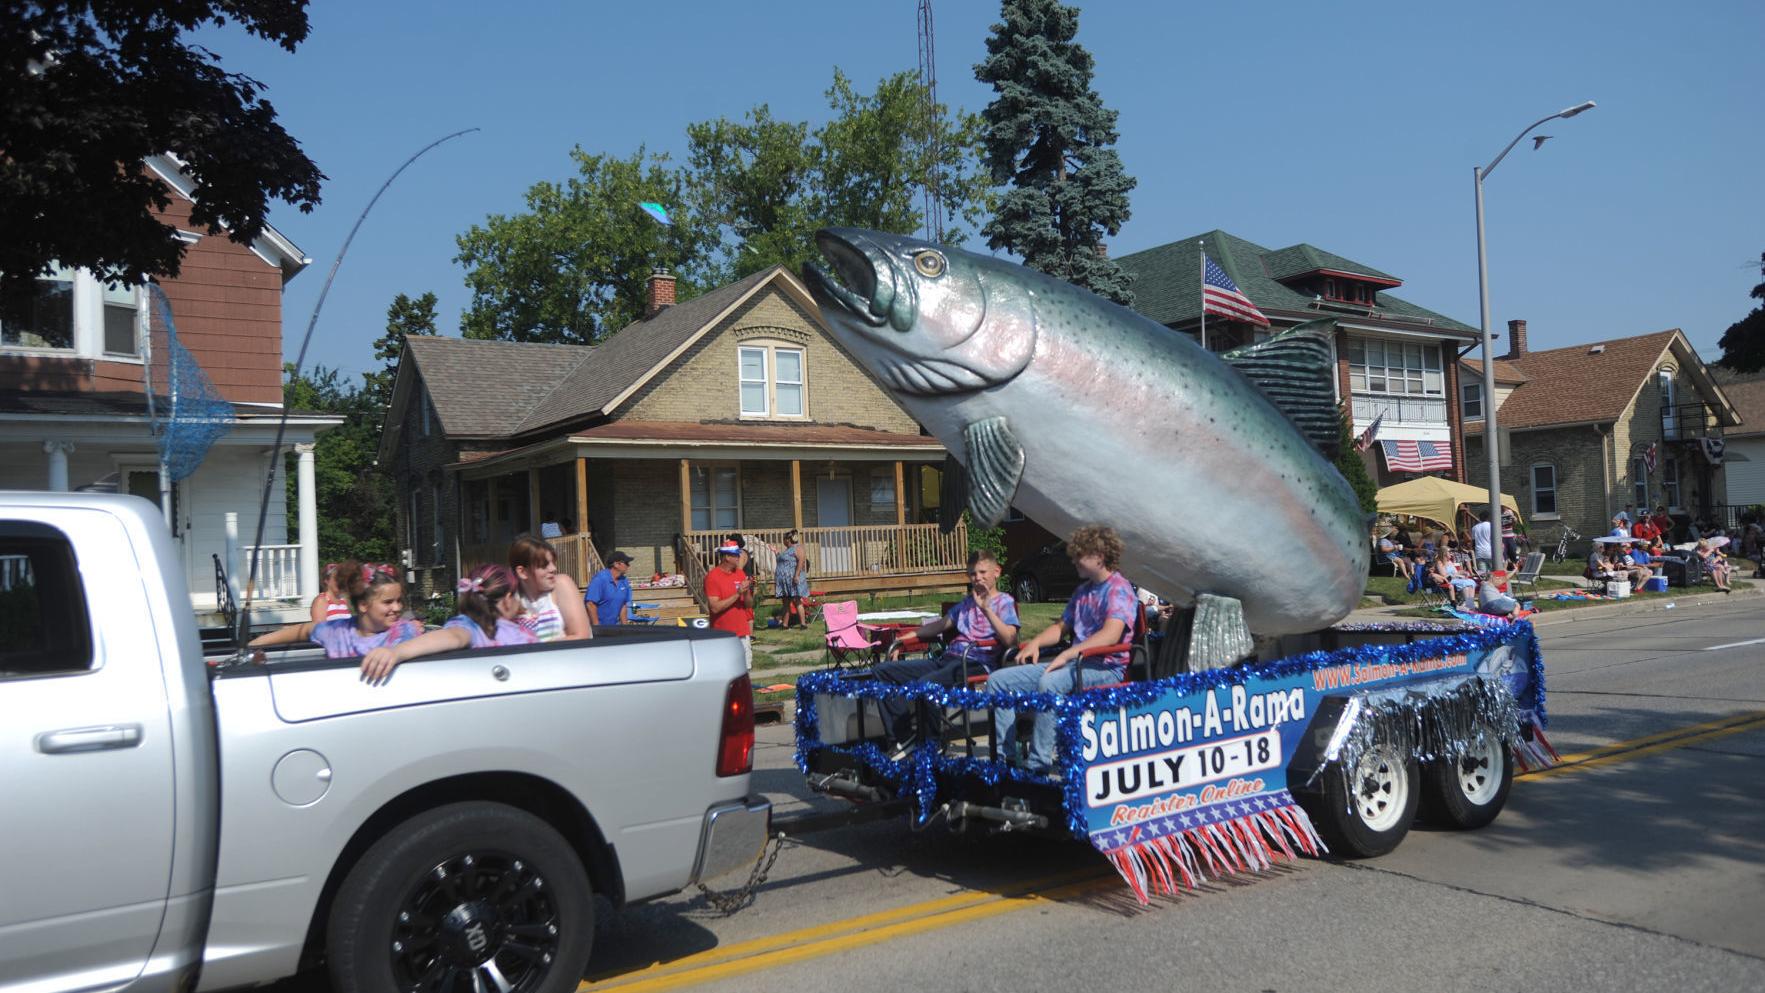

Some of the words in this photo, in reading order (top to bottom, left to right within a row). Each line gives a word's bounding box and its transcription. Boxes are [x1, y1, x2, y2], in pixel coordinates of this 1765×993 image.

[1081, 685, 1305, 762] Salmon-A-Rama
[1095, 755, 1185, 800] JULY
[1111, 794, 1197, 826] Register
[1200, 777, 1265, 805] Online
[465, 921, 487, 950] XD
